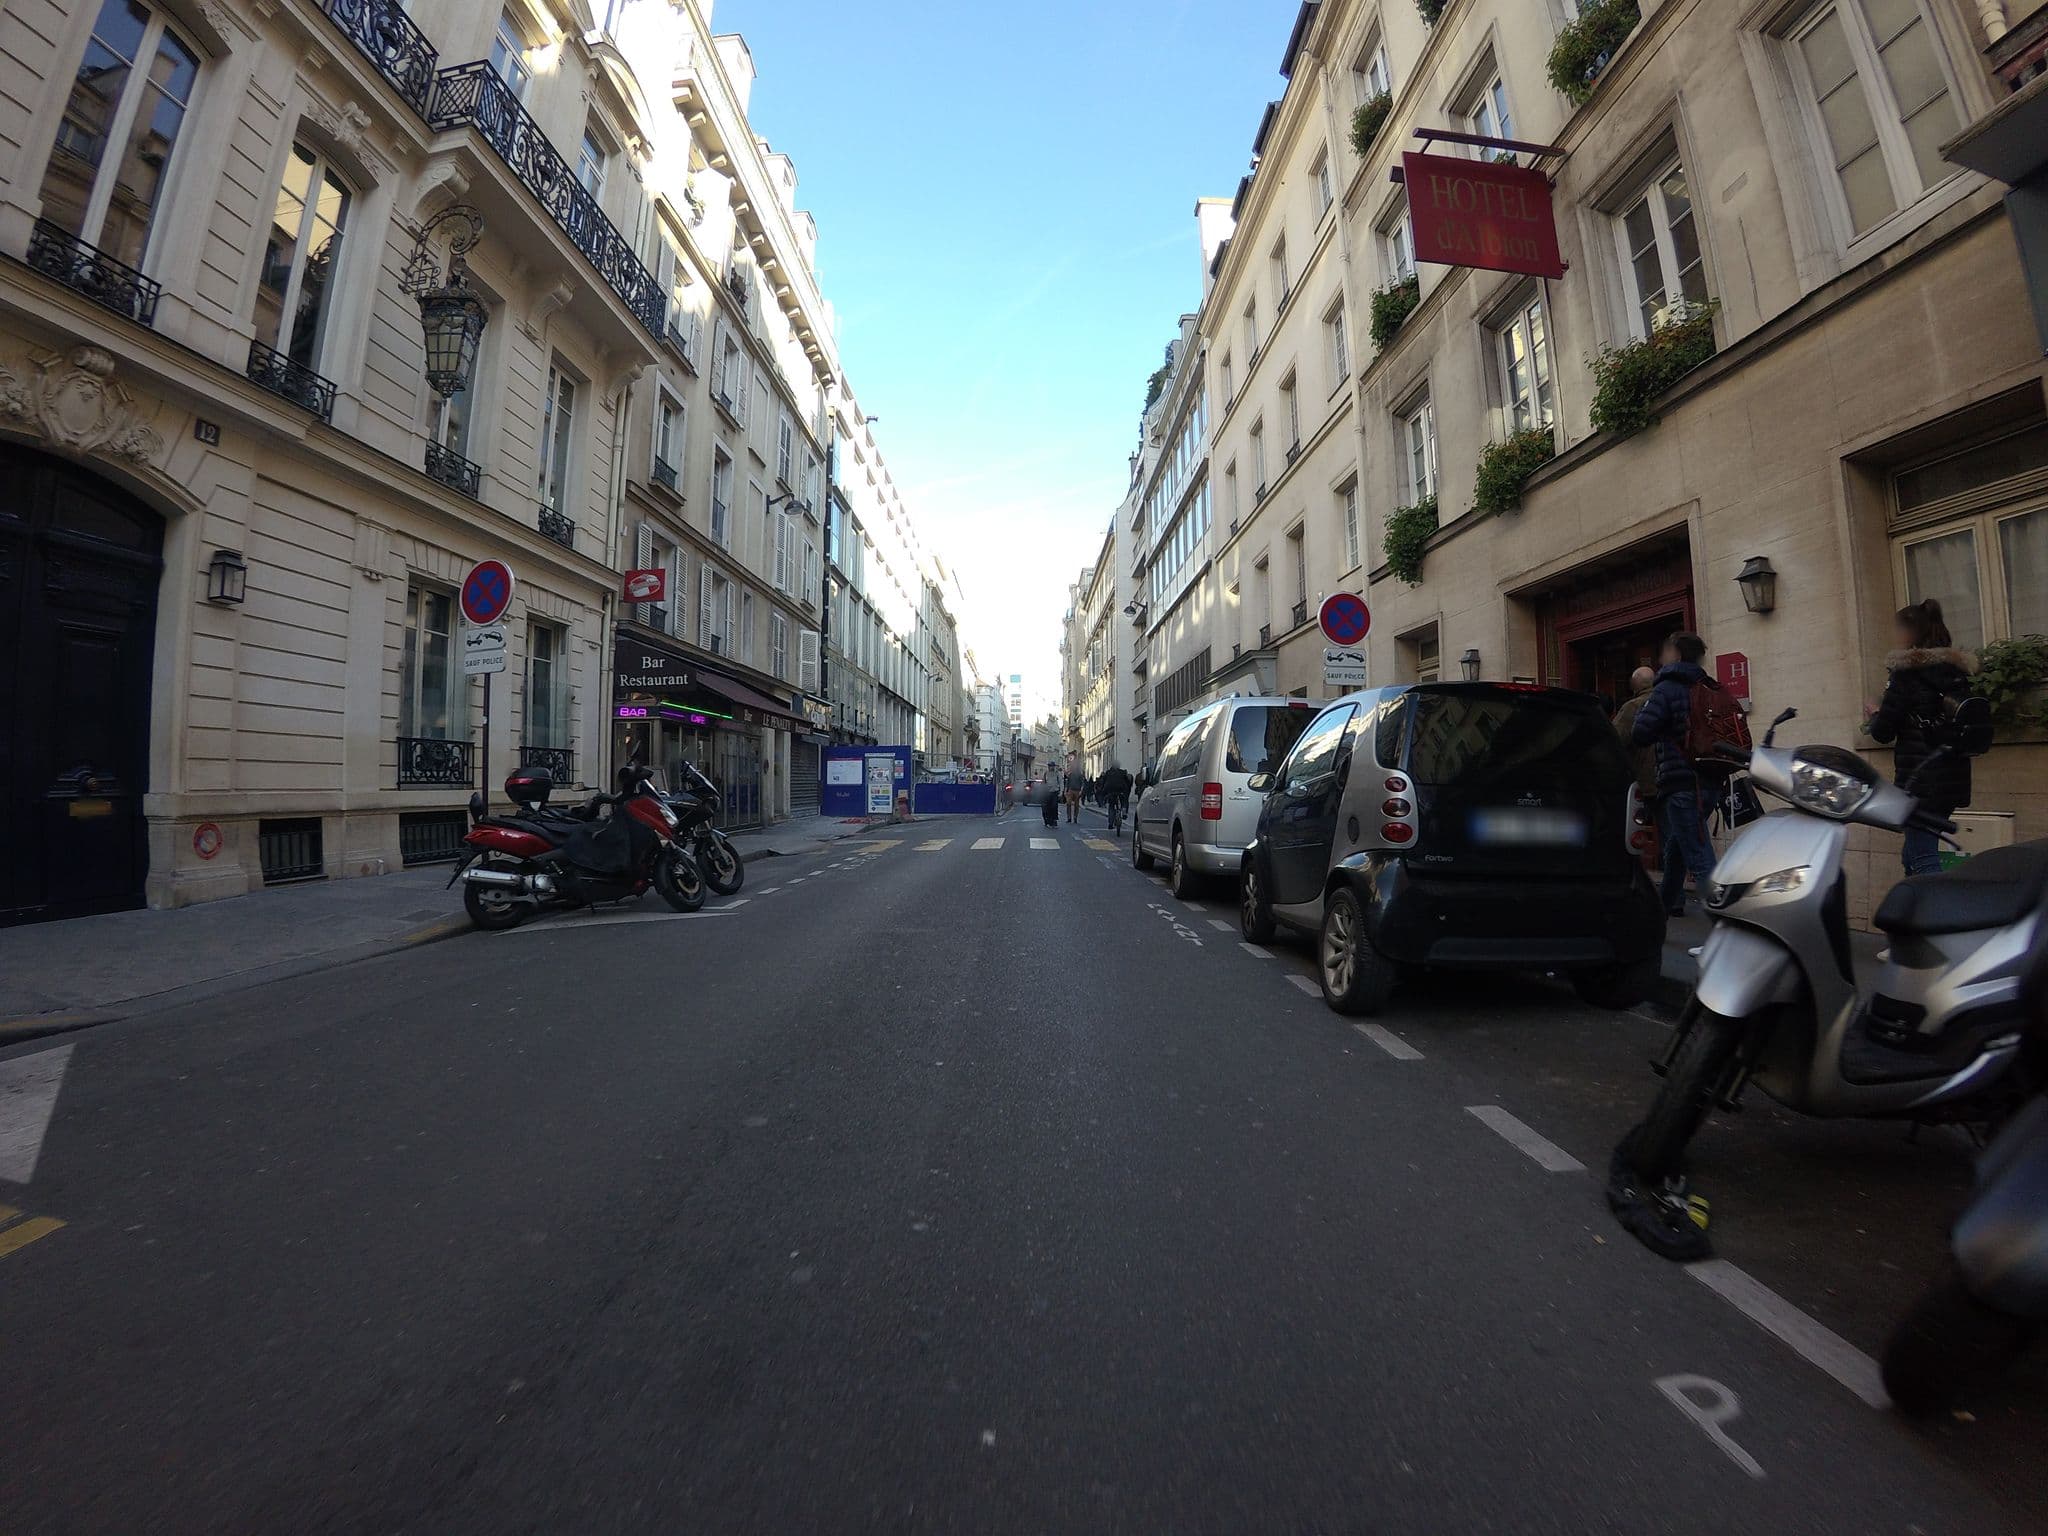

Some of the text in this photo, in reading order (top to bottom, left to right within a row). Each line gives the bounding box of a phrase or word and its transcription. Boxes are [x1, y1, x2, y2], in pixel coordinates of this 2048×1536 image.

[1429, 174, 1538, 223] HOTEL
[465, 657, 503, 667] SAUF POLICE
[642, 656, 665, 669] Bar
[1730, 661, 1747, 679] H
[619, 673, 689, 687] Restaurant
[619, 706, 647, 717] BAR
[1517, 798, 1542, 807] smart
[1653, 1373, 1768, 1479] P
